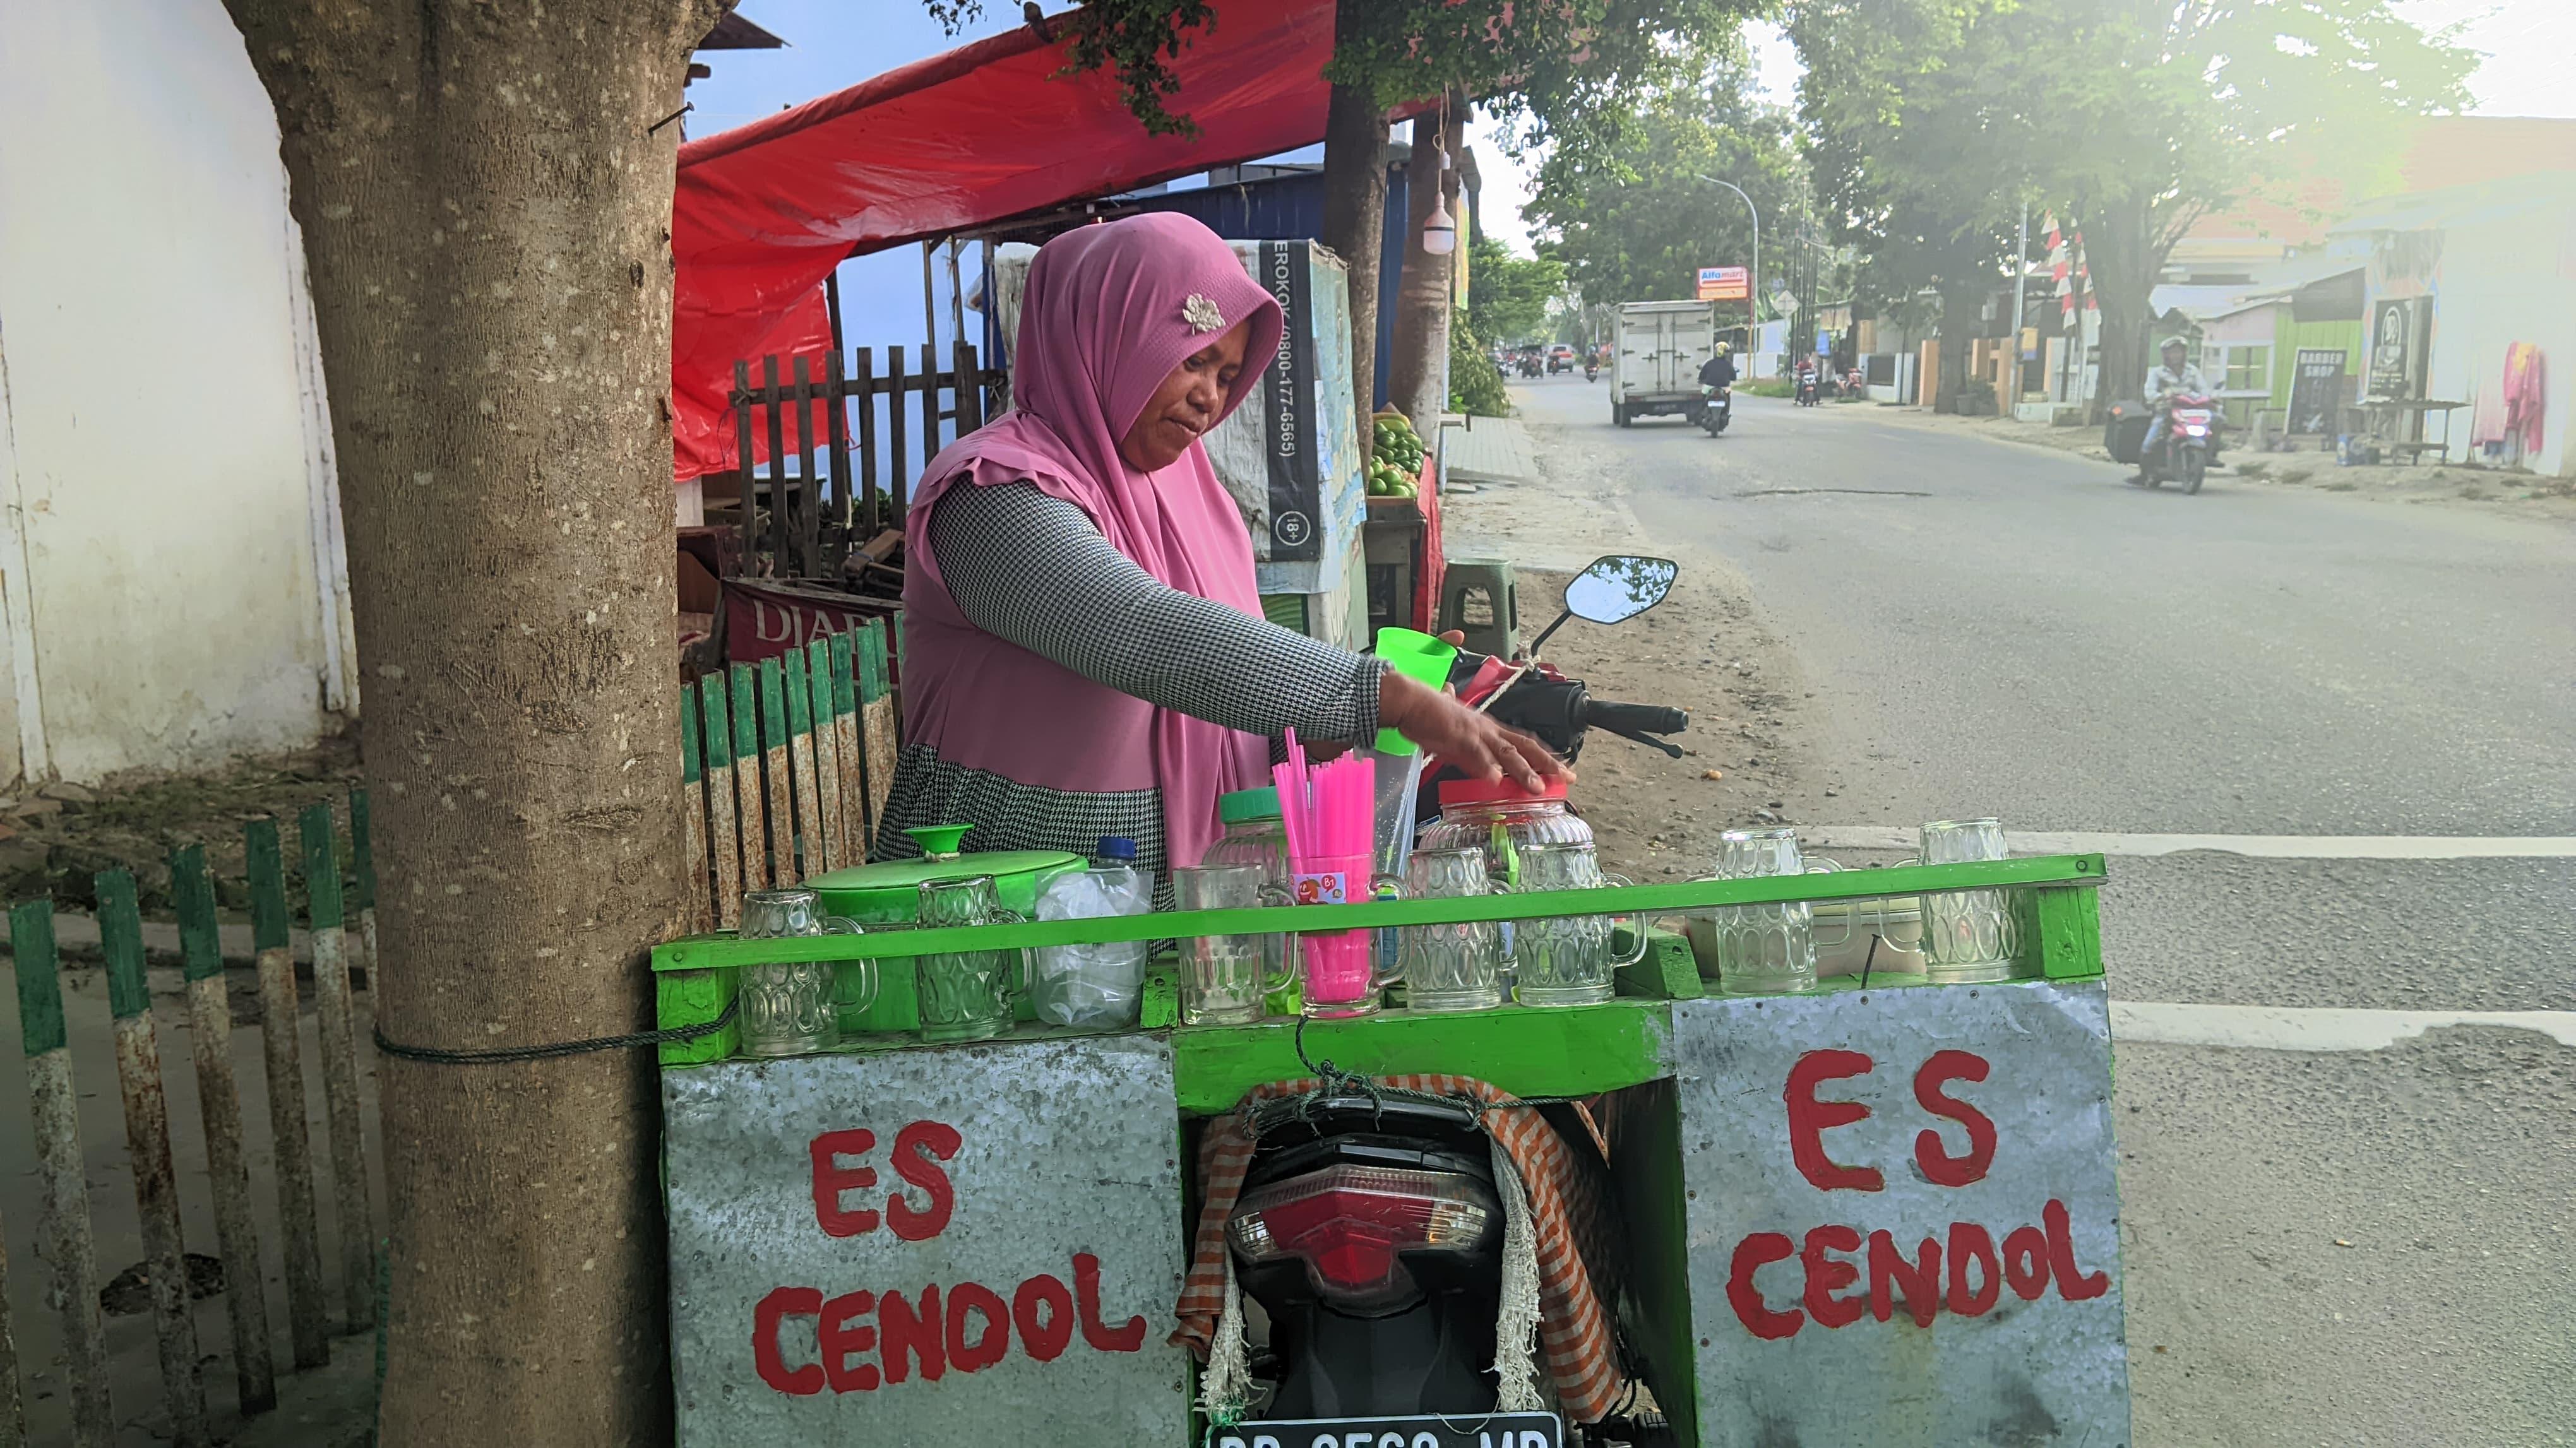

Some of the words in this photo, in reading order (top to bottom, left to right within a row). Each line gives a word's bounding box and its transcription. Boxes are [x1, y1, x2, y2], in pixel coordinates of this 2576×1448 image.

[1702, 270, 1743, 280] Alfamart
[2299, 352, 2344, 364] BARBER
[2304, 365, 2335, 377] SHOP
[809, 1120, 963, 1241] ES
[1783, 1048, 1998, 1192] ES
[753, 1252, 1147, 1395] CENDOL
[1726, 1198, 2111, 1340] CENDOL
